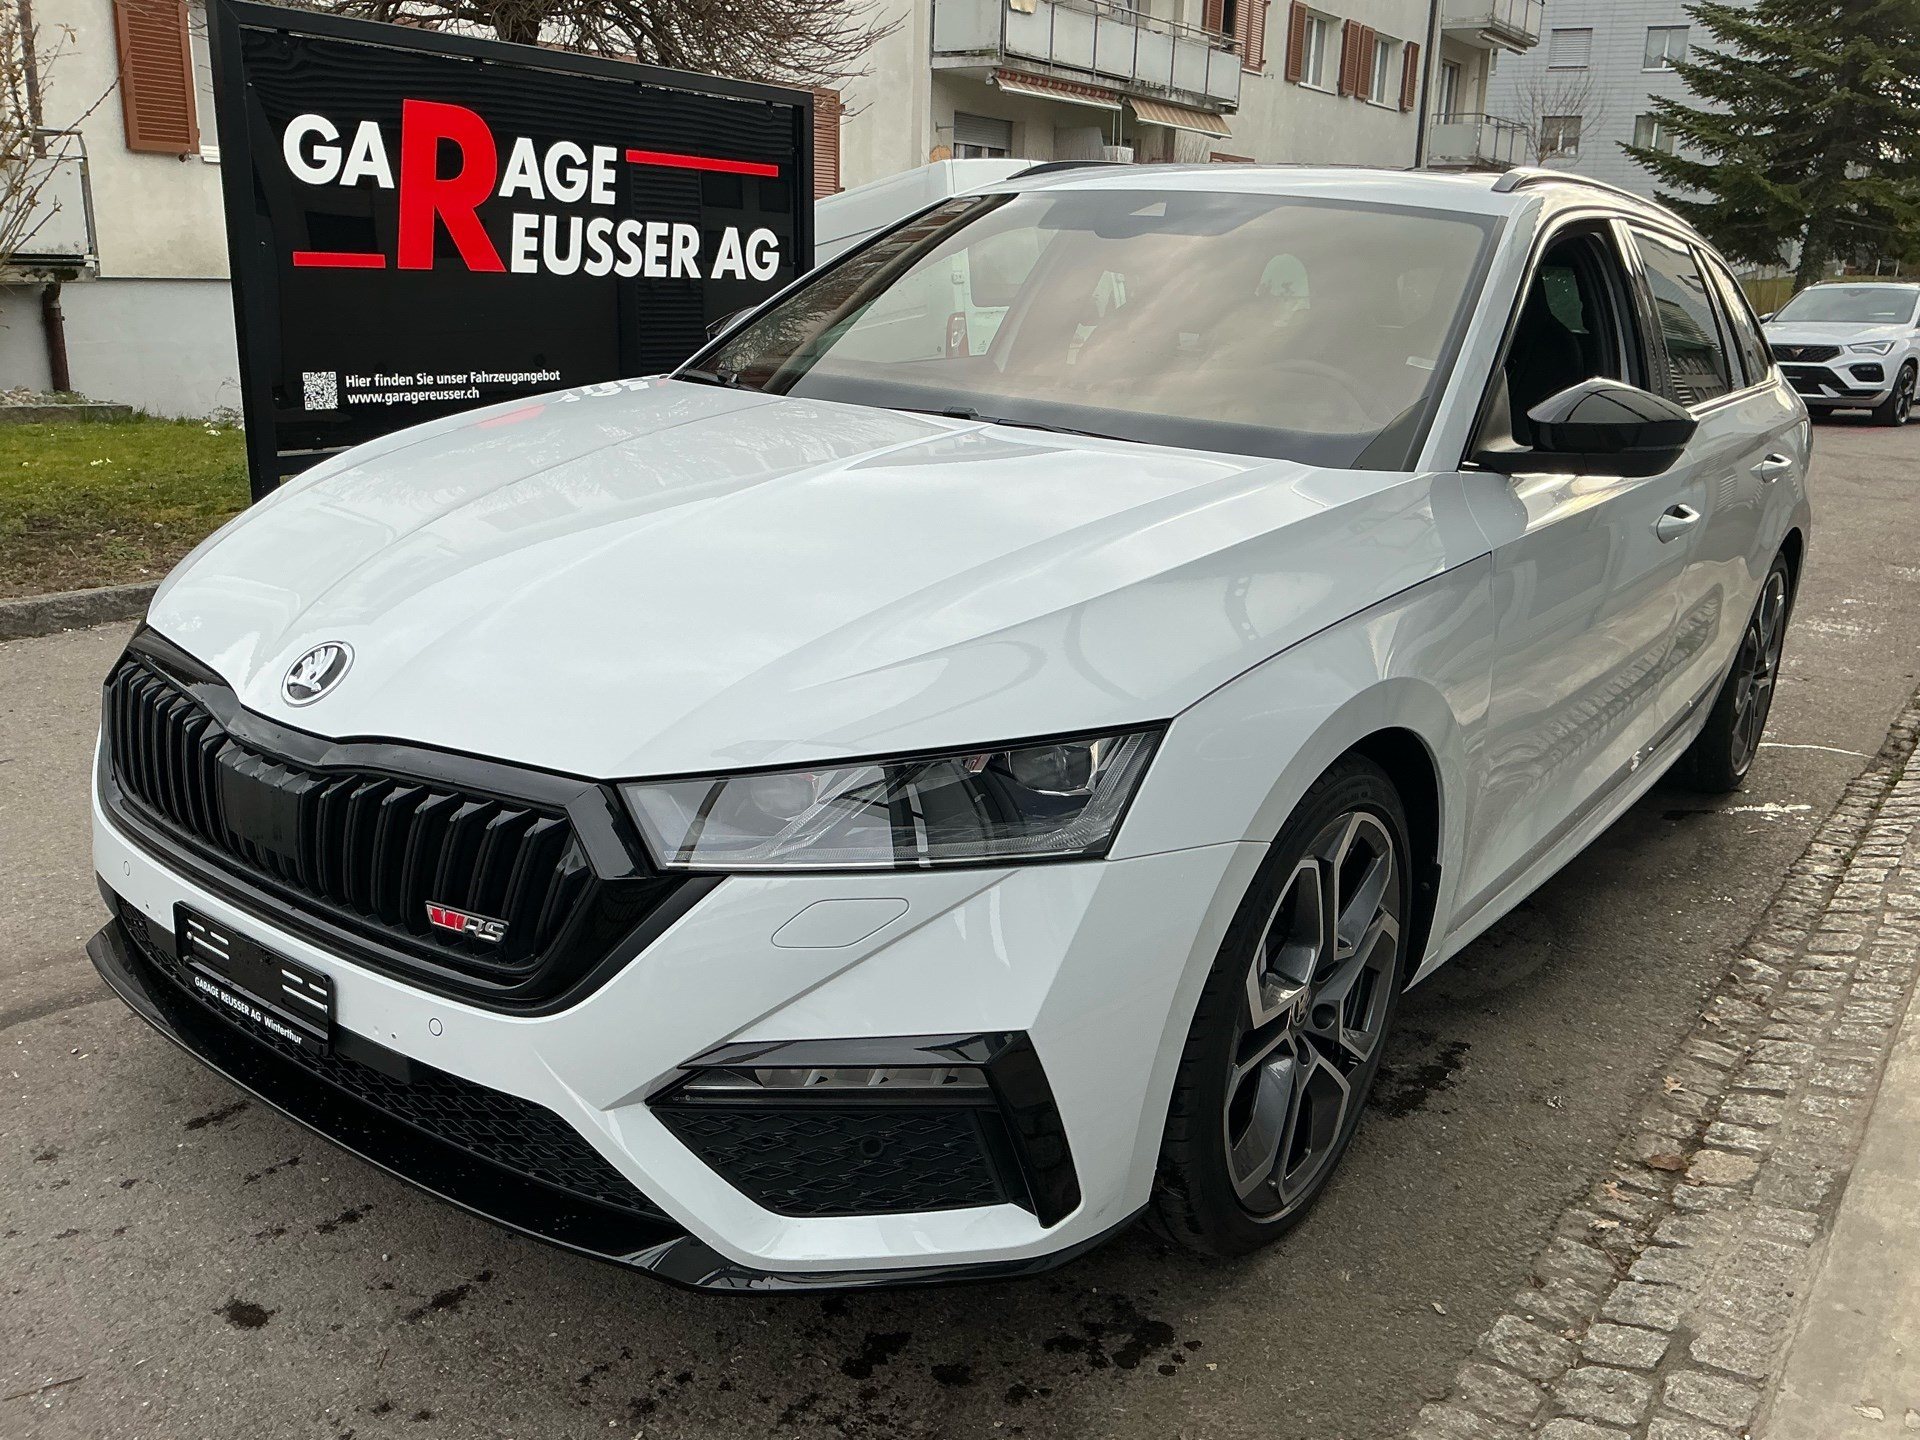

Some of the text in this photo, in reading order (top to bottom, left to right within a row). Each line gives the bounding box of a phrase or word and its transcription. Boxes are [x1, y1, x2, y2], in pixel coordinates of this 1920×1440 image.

[283, 98, 618, 273] GARAGE
[710, 227, 780, 282] AG
[345, 369, 561, 388] Hier finden Sie unser Fahrzeugangebot
[348, 385, 480, 405] www.garagereusser.ch
[194, 976, 303, 1045] GARAGE REUSSER AG Winterthur
